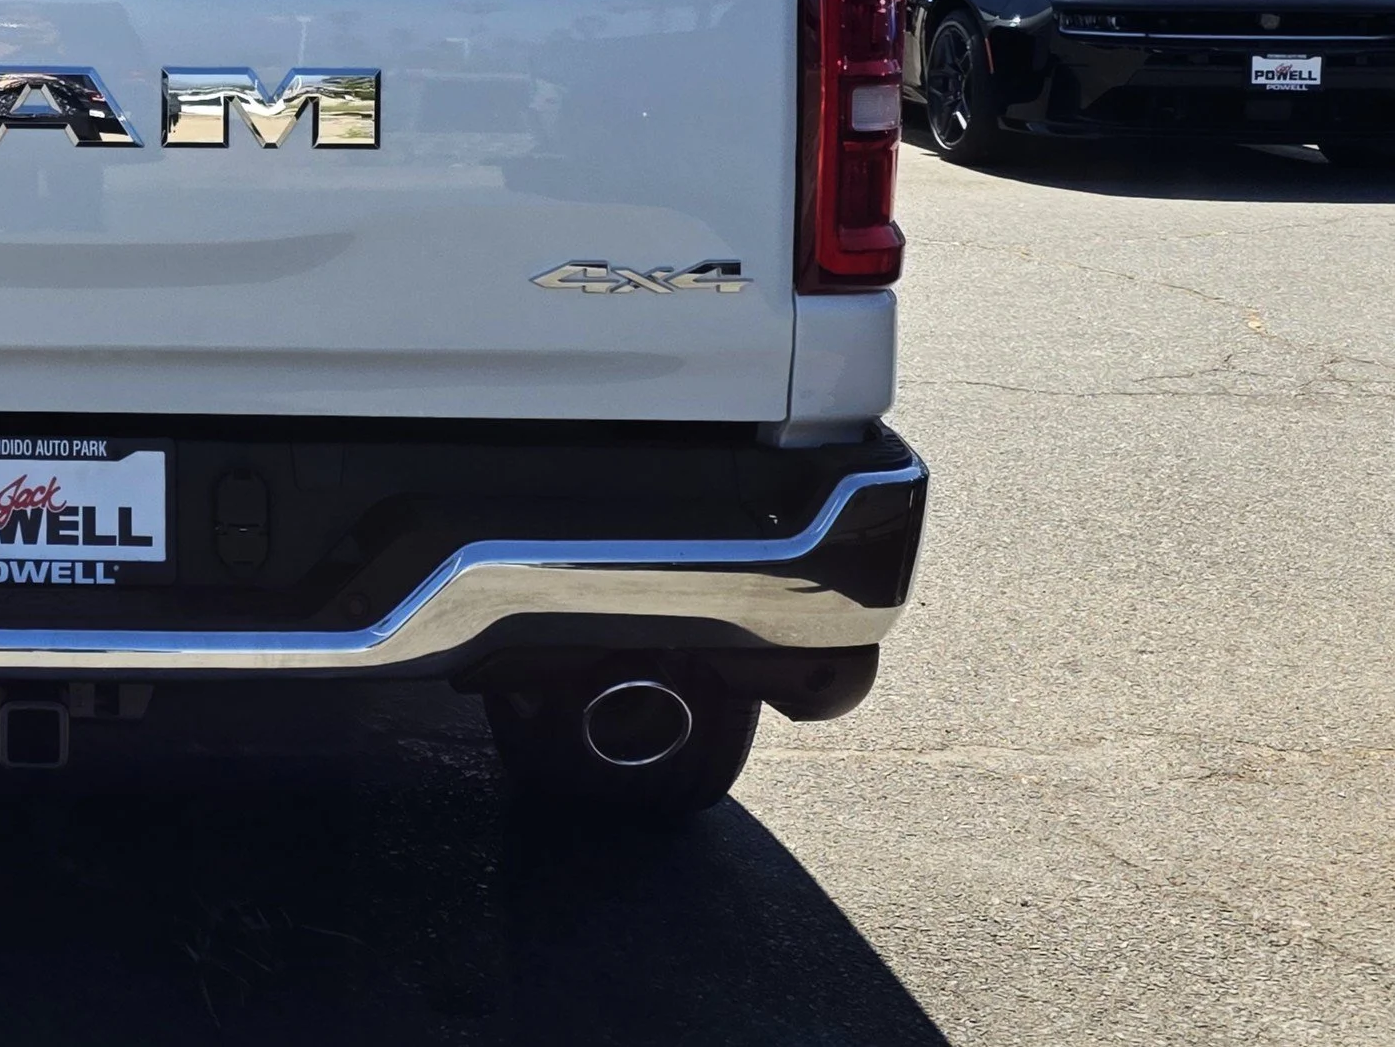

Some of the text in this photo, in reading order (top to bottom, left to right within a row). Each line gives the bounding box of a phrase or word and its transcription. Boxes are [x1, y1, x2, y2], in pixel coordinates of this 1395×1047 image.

[1254, 70, 1317, 81] POWELL
[35, 440, 69, 456] AUTO
[73, 441, 107, 456] PARK
